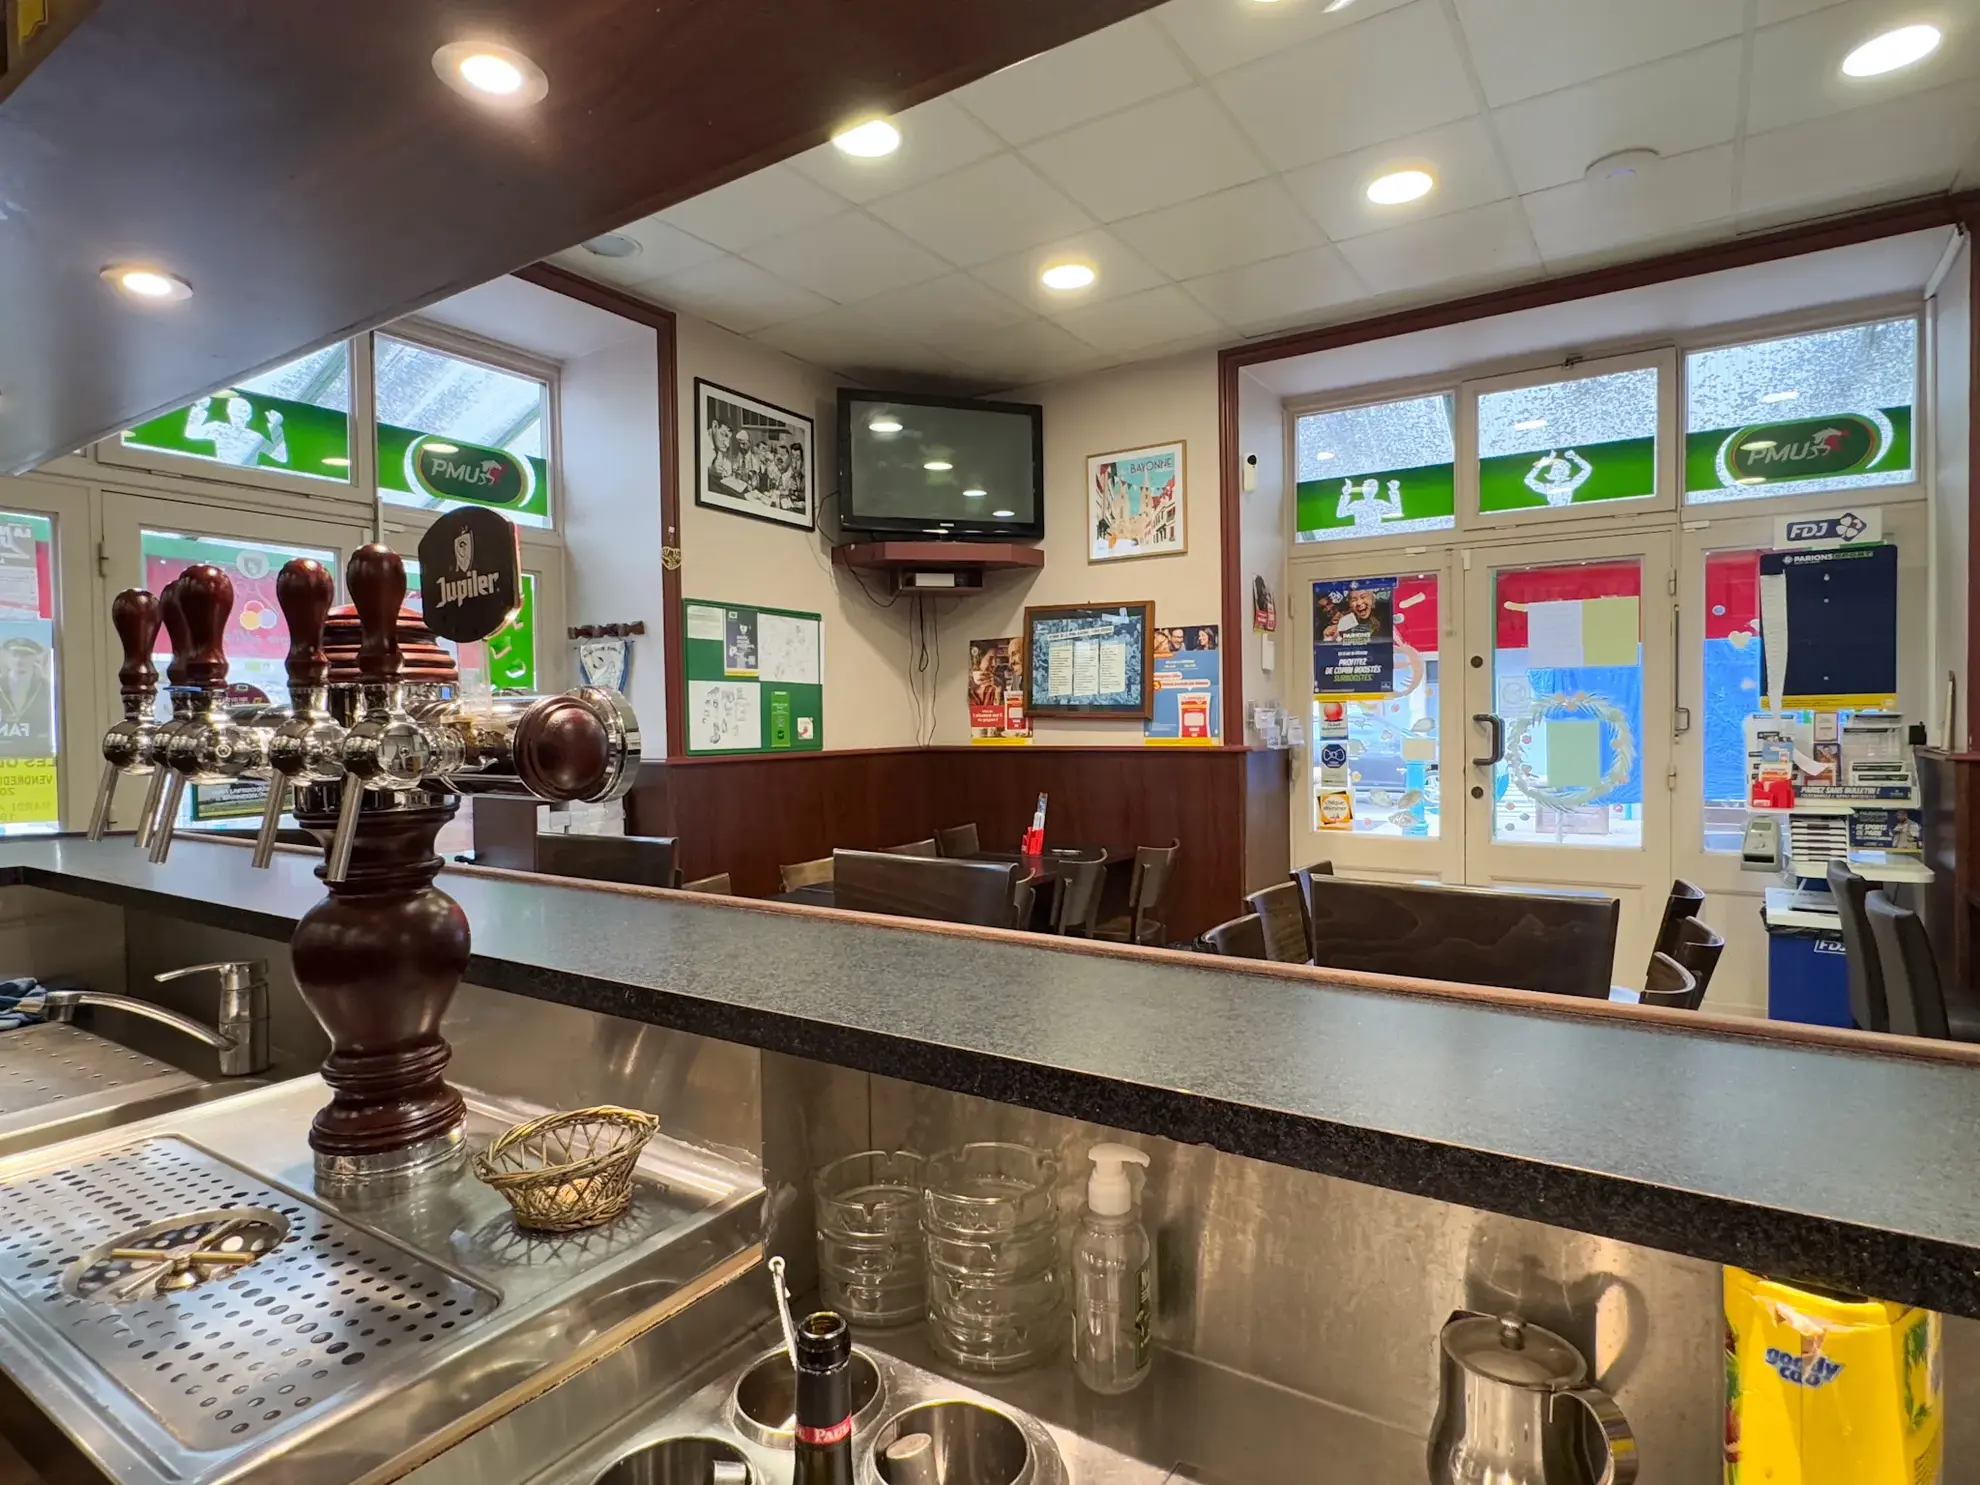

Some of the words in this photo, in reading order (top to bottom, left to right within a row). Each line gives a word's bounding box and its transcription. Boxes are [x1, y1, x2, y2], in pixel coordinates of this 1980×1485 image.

[1747, 441, 1811, 466] PMU
[431, 458, 480, 483] PMU
[1130, 458, 1173, 474] BAYONNE
[1789, 522, 1829, 539] FDJ
[1793, 553, 1833, 562] PARIONS
[436, 570, 499, 609] Jupiler
